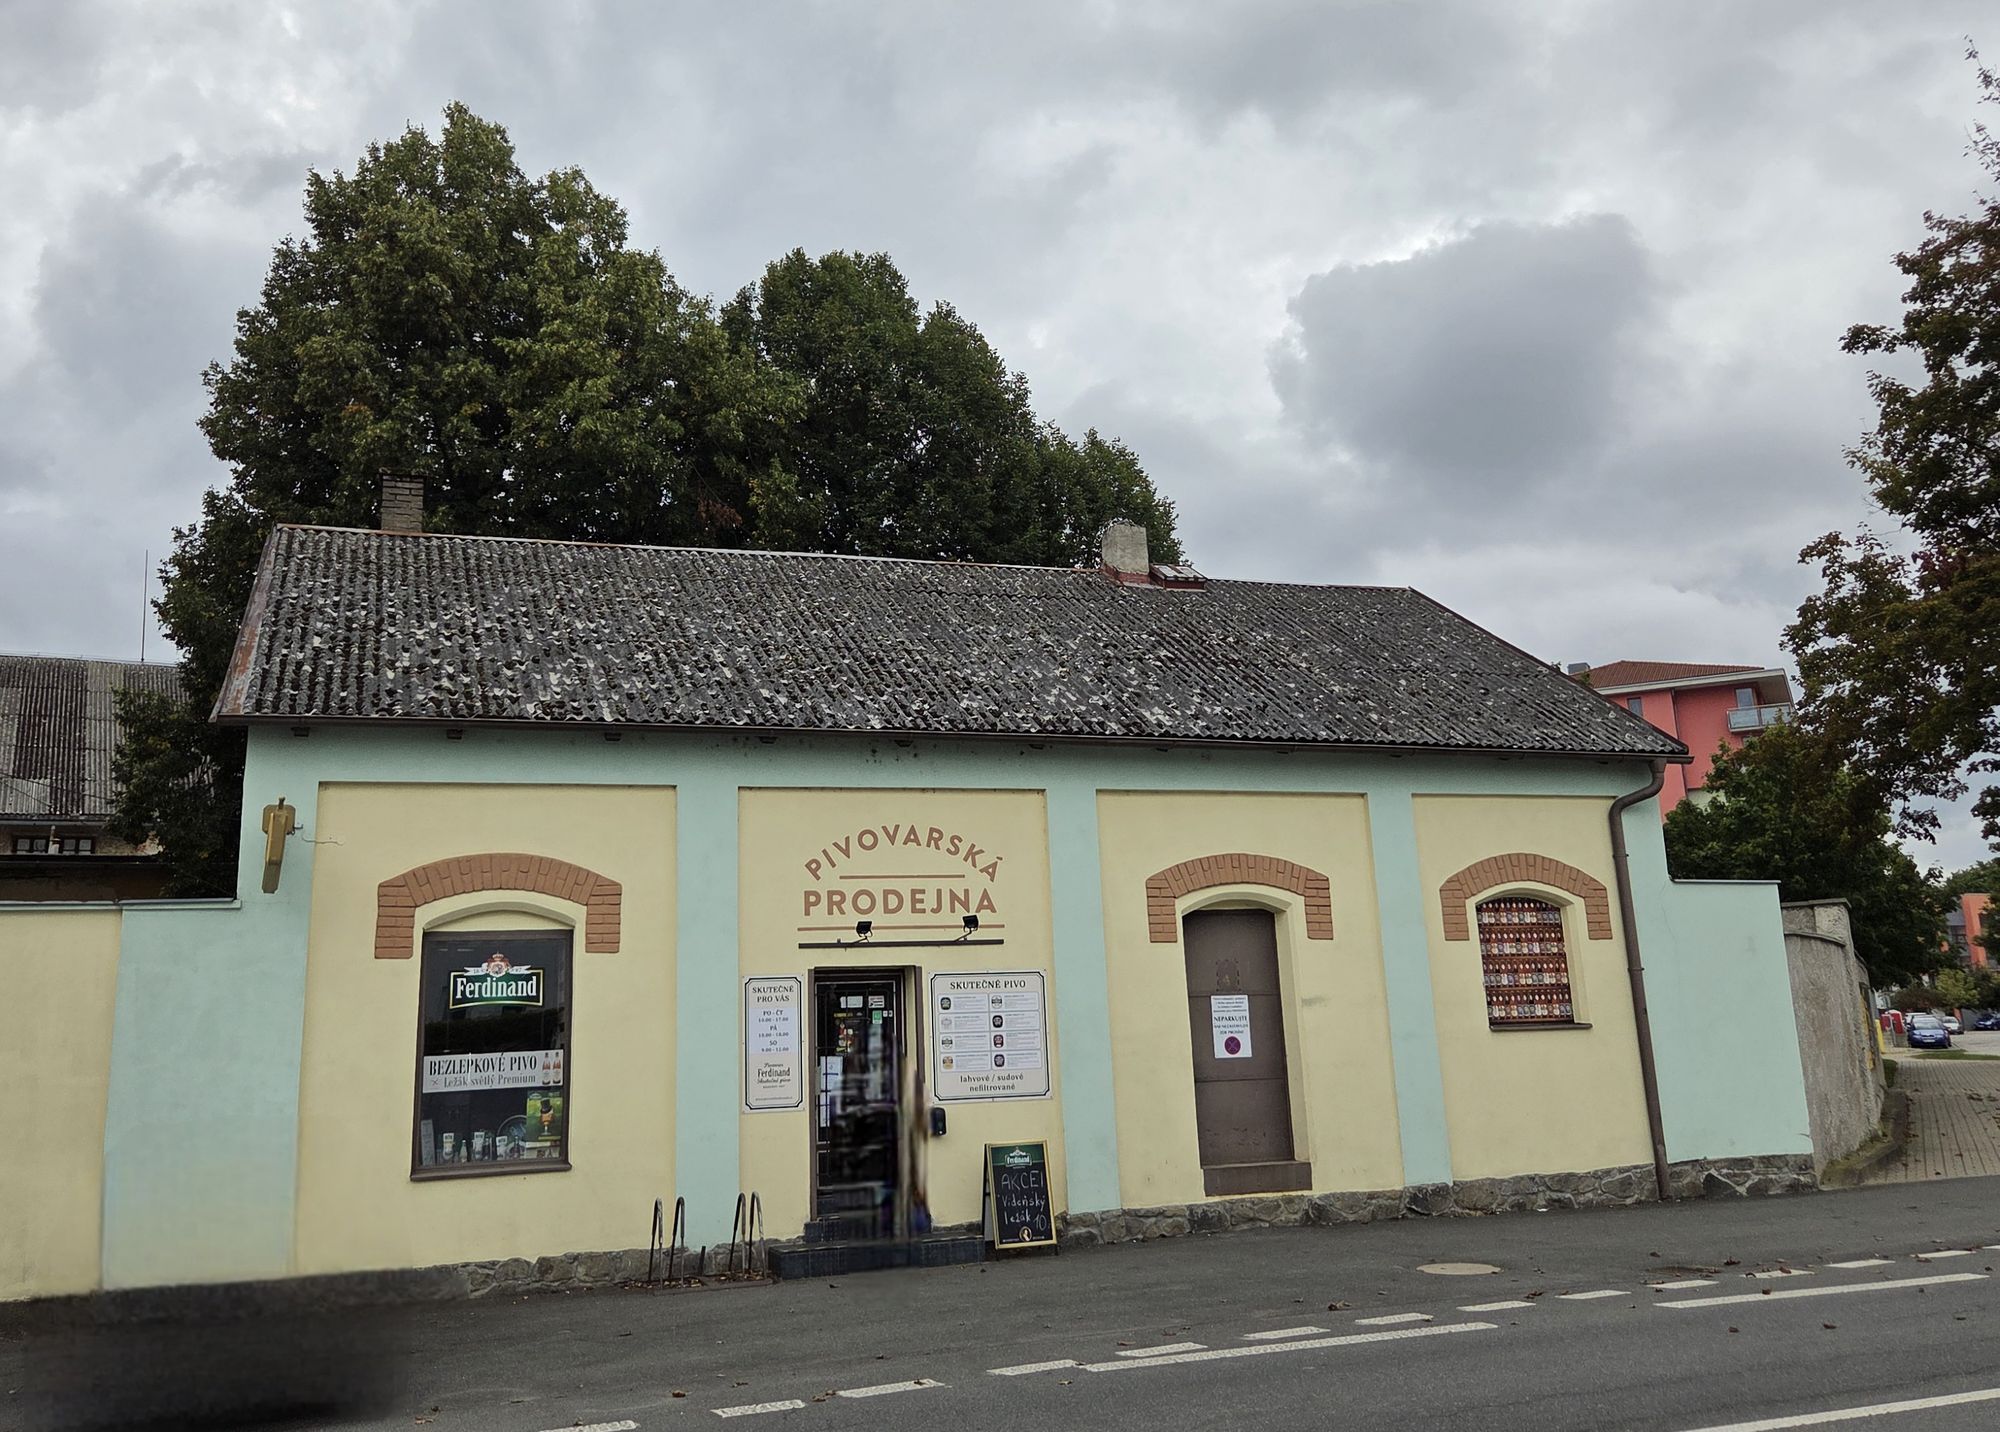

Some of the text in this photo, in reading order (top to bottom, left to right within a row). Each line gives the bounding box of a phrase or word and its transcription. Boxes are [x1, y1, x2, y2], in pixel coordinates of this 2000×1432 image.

[805, 824, 1003, 882] PIVOVARSKÁ
[804, 888, 997, 917] PRODEJNA
[455, 975, 537, 999] Ferdinand
[1003, 980, 1026, 989] PIVO
[757, 994, 790, 1003] PRO VÁS
[429, 1052, 537, 1076] BEZLEPKOVÉ PIVO
[498, 1073, 536, 1085] Premium
[960, 1074, 990, 1083] lahvové
[997, 1072, 1024, 1081] sudové
[969, 1083, 1016, 1092] nefiltrované
